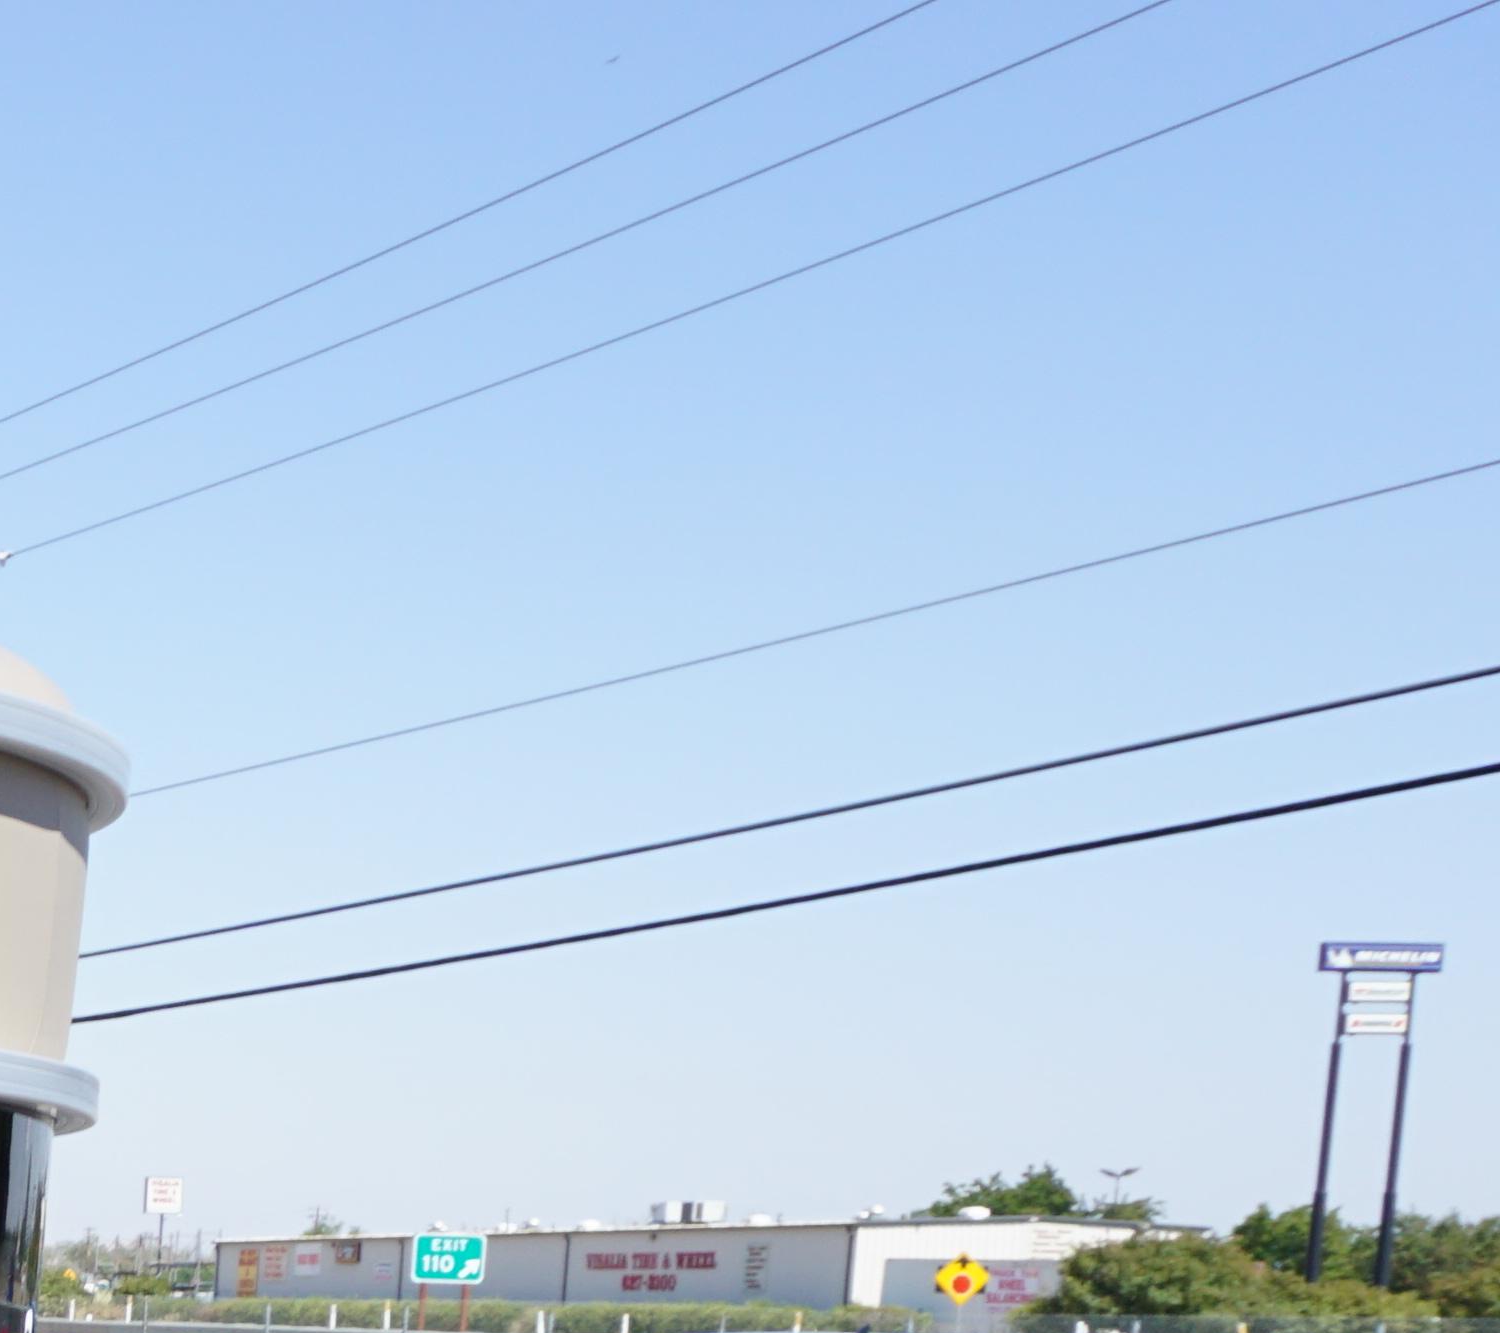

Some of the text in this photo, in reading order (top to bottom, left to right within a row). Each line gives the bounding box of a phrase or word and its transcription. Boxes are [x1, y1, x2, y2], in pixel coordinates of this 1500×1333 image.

[430, 1238, 468, 1252] EXIT
[420, 1254, 455, 1273] 110
[675, 1251, 717, 1270] WHEEL
